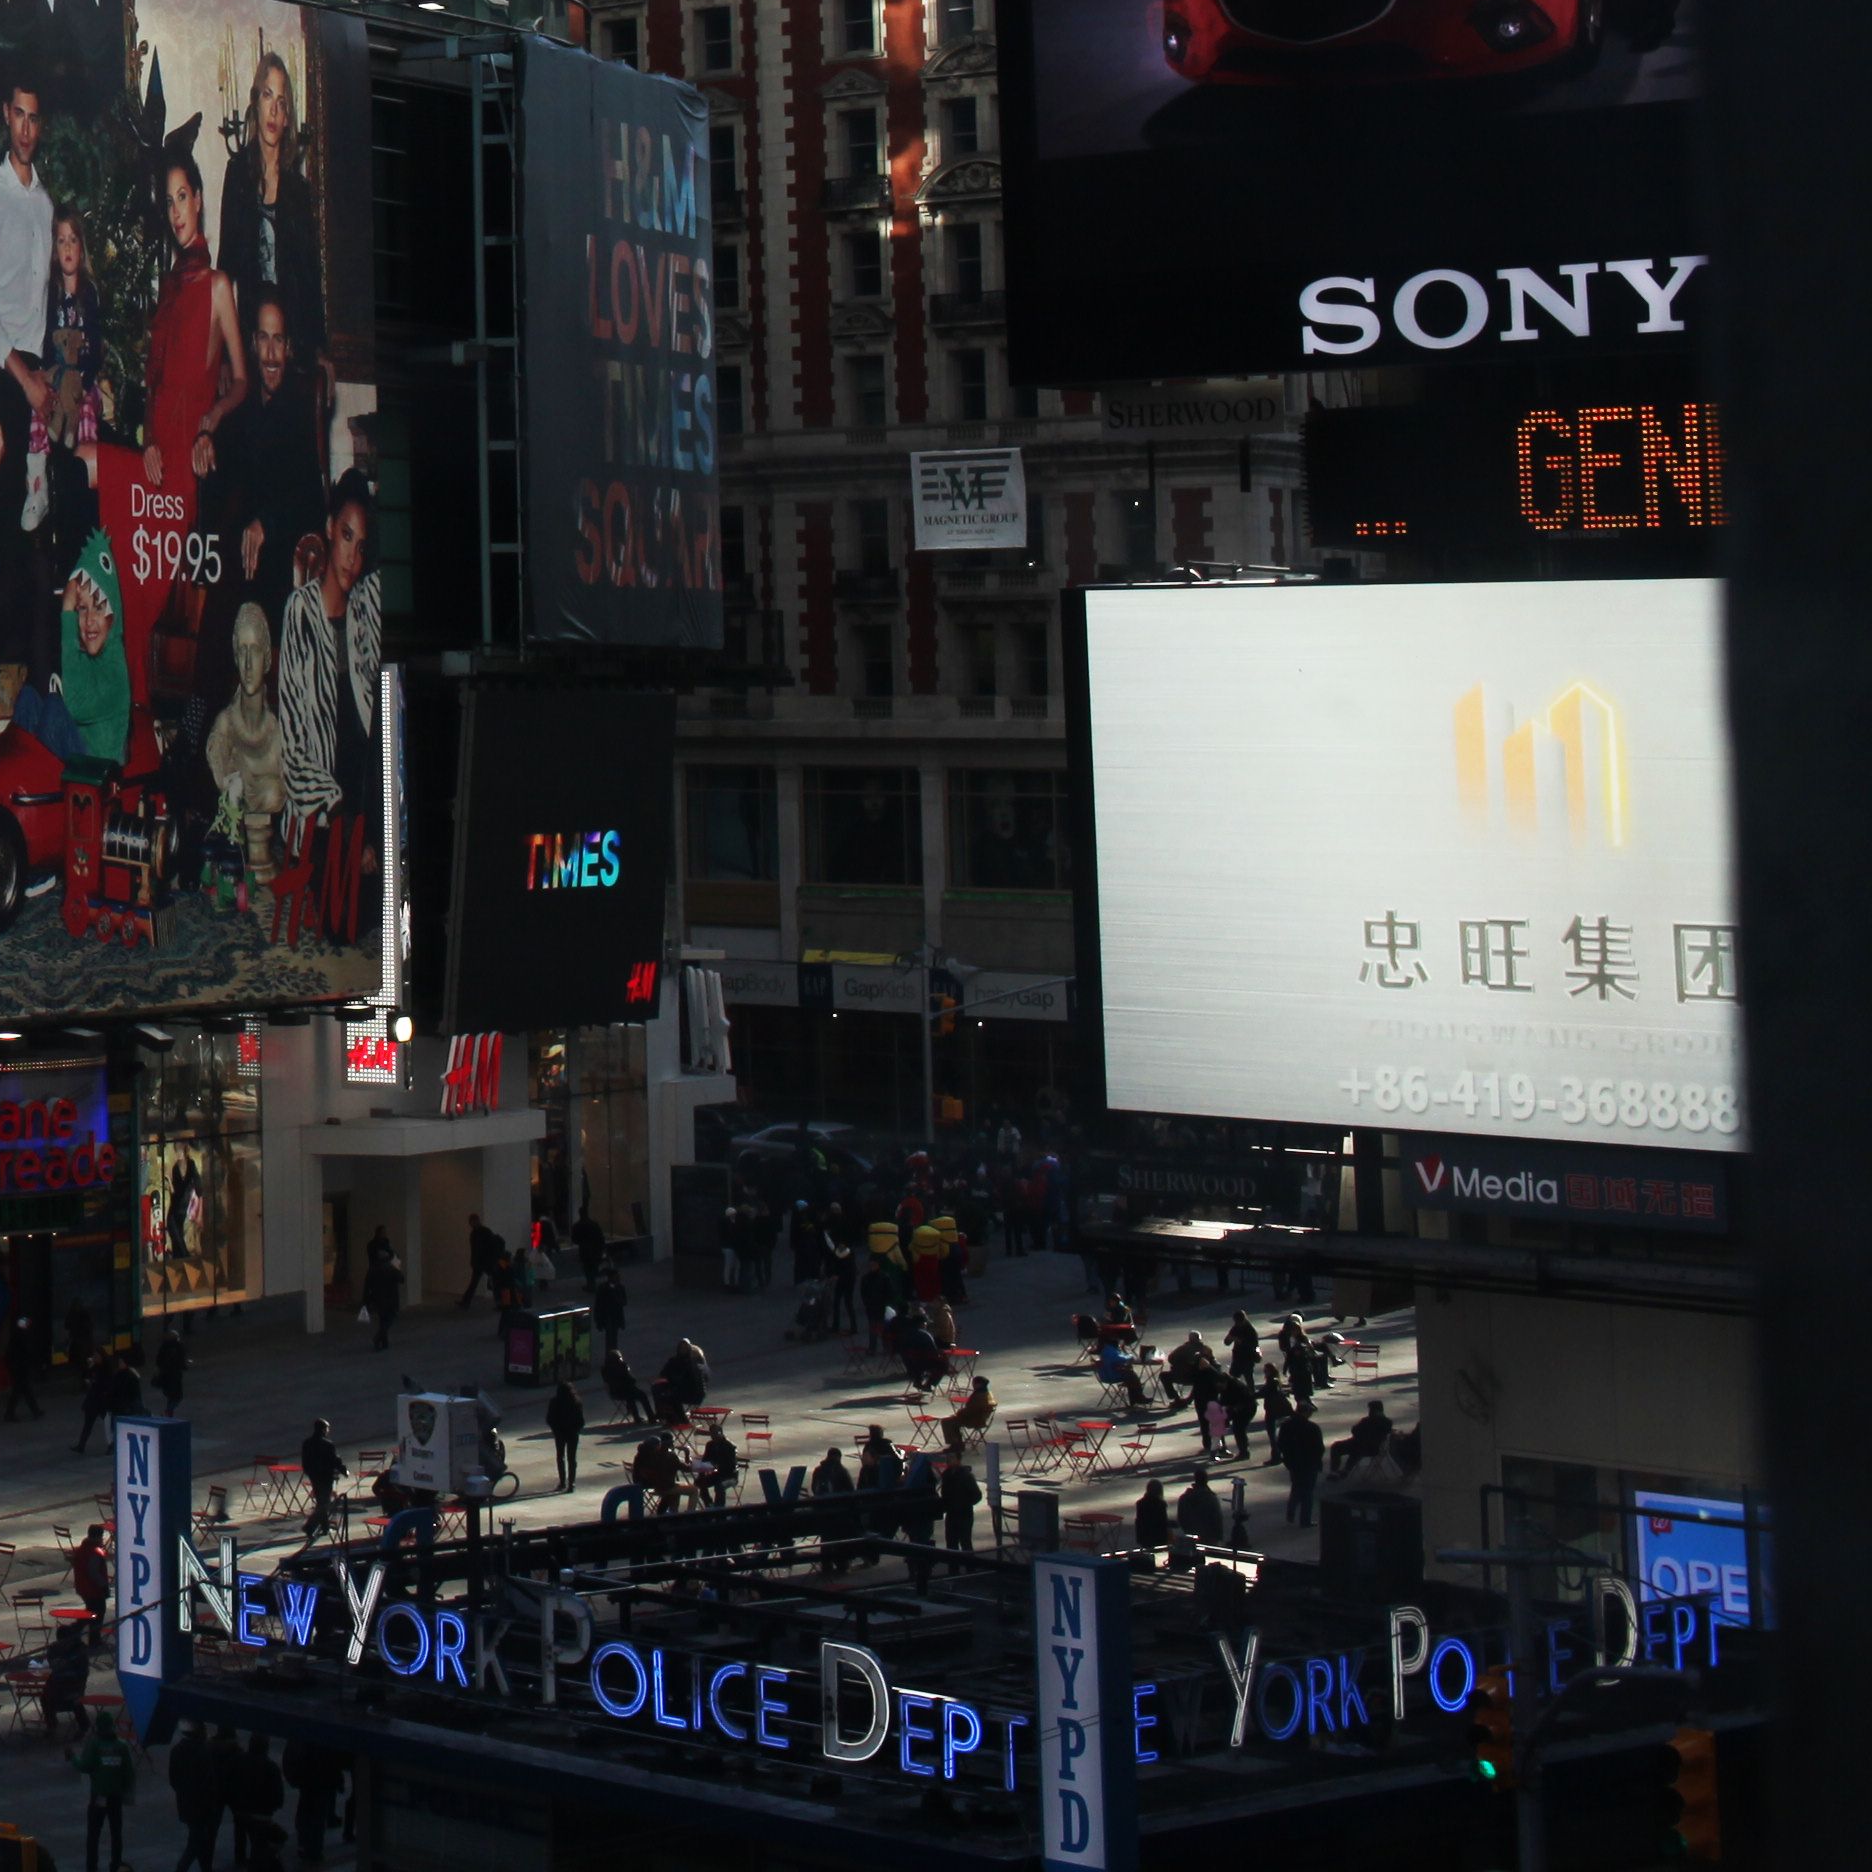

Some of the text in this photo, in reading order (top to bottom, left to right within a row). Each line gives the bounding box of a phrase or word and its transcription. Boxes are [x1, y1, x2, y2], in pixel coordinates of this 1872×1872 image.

[585, 233, 712, 360] LOVES
[1299, 255, 1709, 355] SONY
[1108, 392, 1277, 430] SHERWOOD
[130, 481, 187, 523] Dress
[923, 513, 1018, 526] MAGNETIC GROUP
[130, 530, 223, 588] $19.95
[524, 829, 622, 891] TIMES
[1358, 910, 1740, 1005] 忠旺集团
[844, 978, 915, 1002] GapKids
[974, 983, 1055, 1012] babyGap
[1117, 1161, 1258, 1198] SHERWOOD
[1452, 1165, 1559, 1205] Media
[125, 1431, 152, 1669] NYPD
[1650, 1556, 1749, 1615] OPE
[176, 1532, 1029, 1793] NEW YORK POLICE DEPT
[1217, 1628, 1370, 1749] YORK
[1049, 1574, 1092, 1854] NYPD
